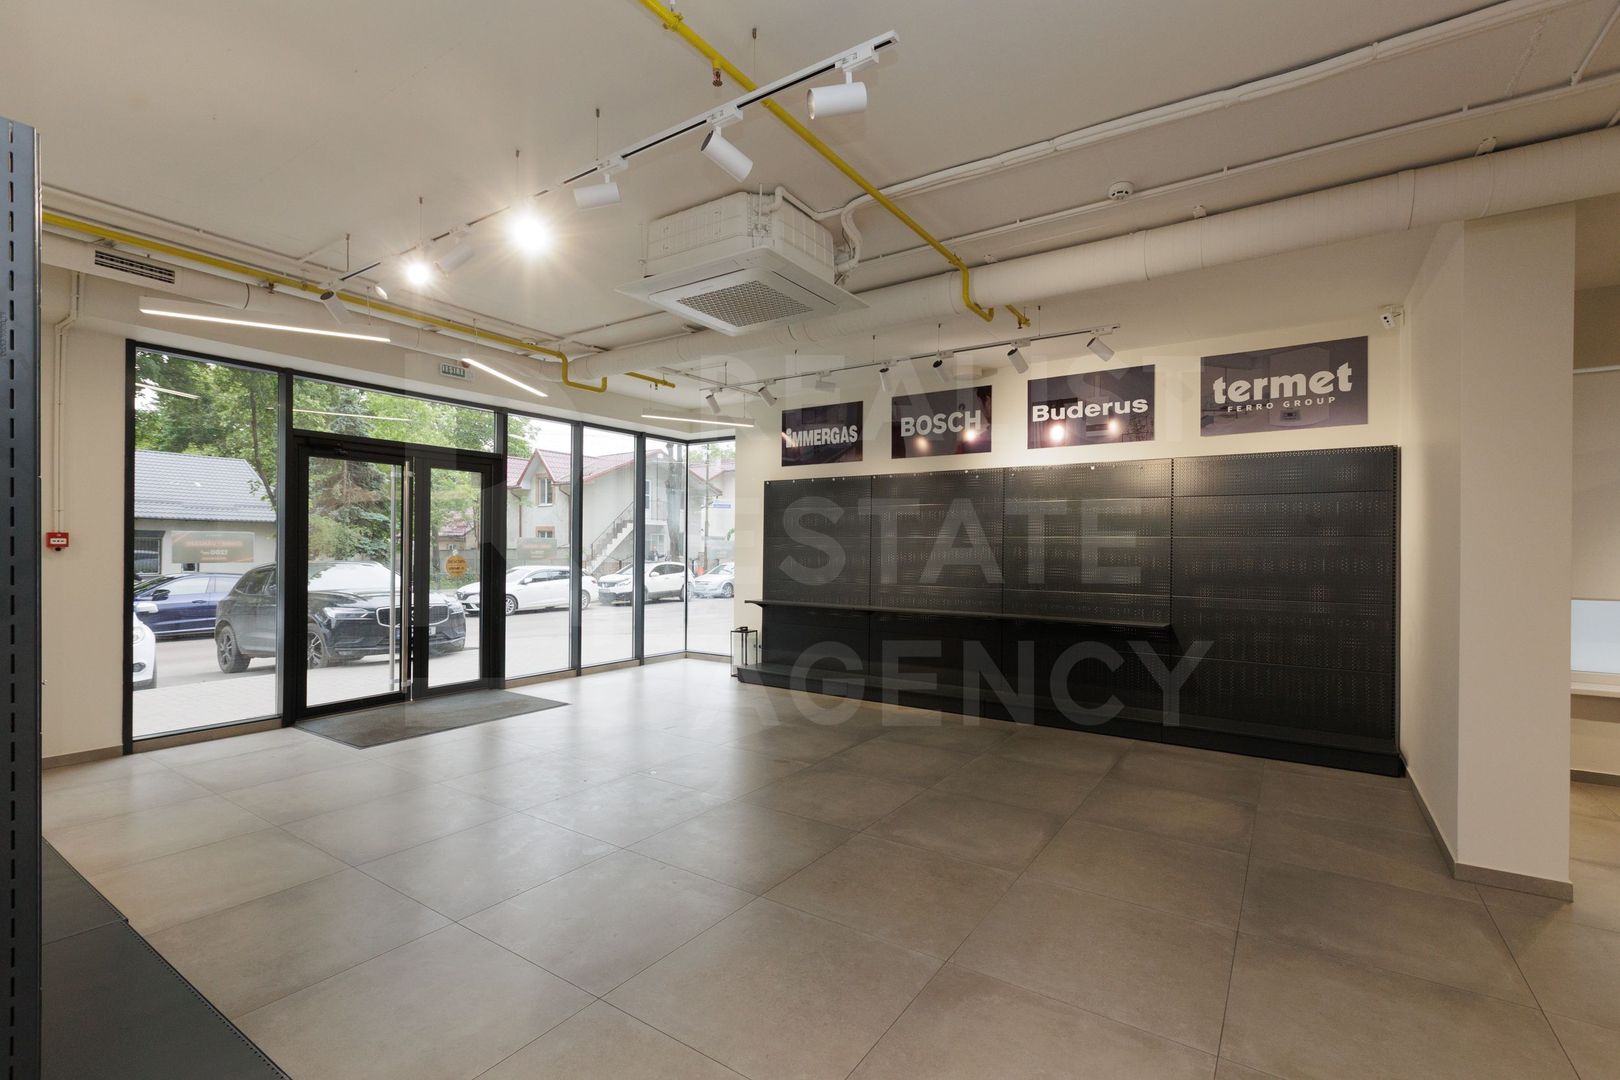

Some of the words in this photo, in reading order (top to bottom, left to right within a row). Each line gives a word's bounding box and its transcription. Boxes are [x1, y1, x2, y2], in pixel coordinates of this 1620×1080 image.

[1213, 362, 1353, 404] termet
[1032, 399, 1149, 422] Buderus
[1227, 402, 1274, 413] FERRO
[1283, 396, 1336, 408] GROUP
[901, 409, 981, 437] BOSCH
